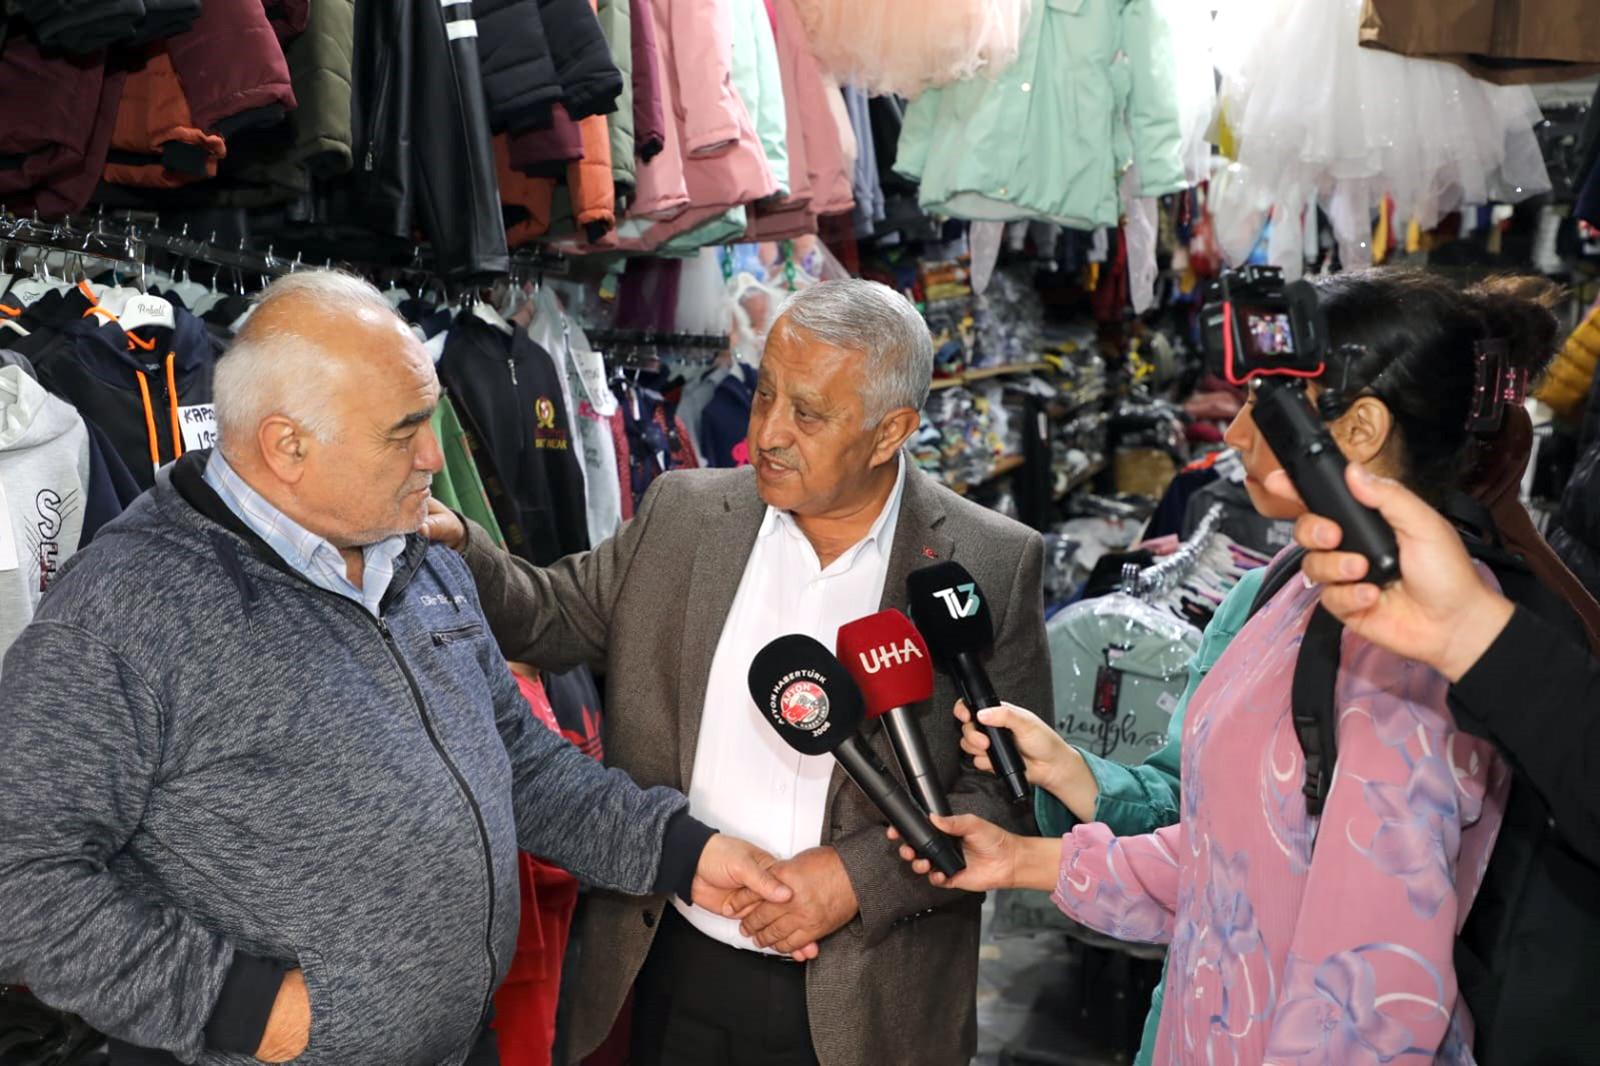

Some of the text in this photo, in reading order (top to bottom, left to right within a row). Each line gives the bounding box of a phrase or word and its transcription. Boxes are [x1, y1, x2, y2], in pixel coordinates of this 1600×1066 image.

[932, 583, 980, 619] TV3
[859, 638, 923, 674] UHA
[770, 669, 827, 725] AFYON HABERTÜRK
